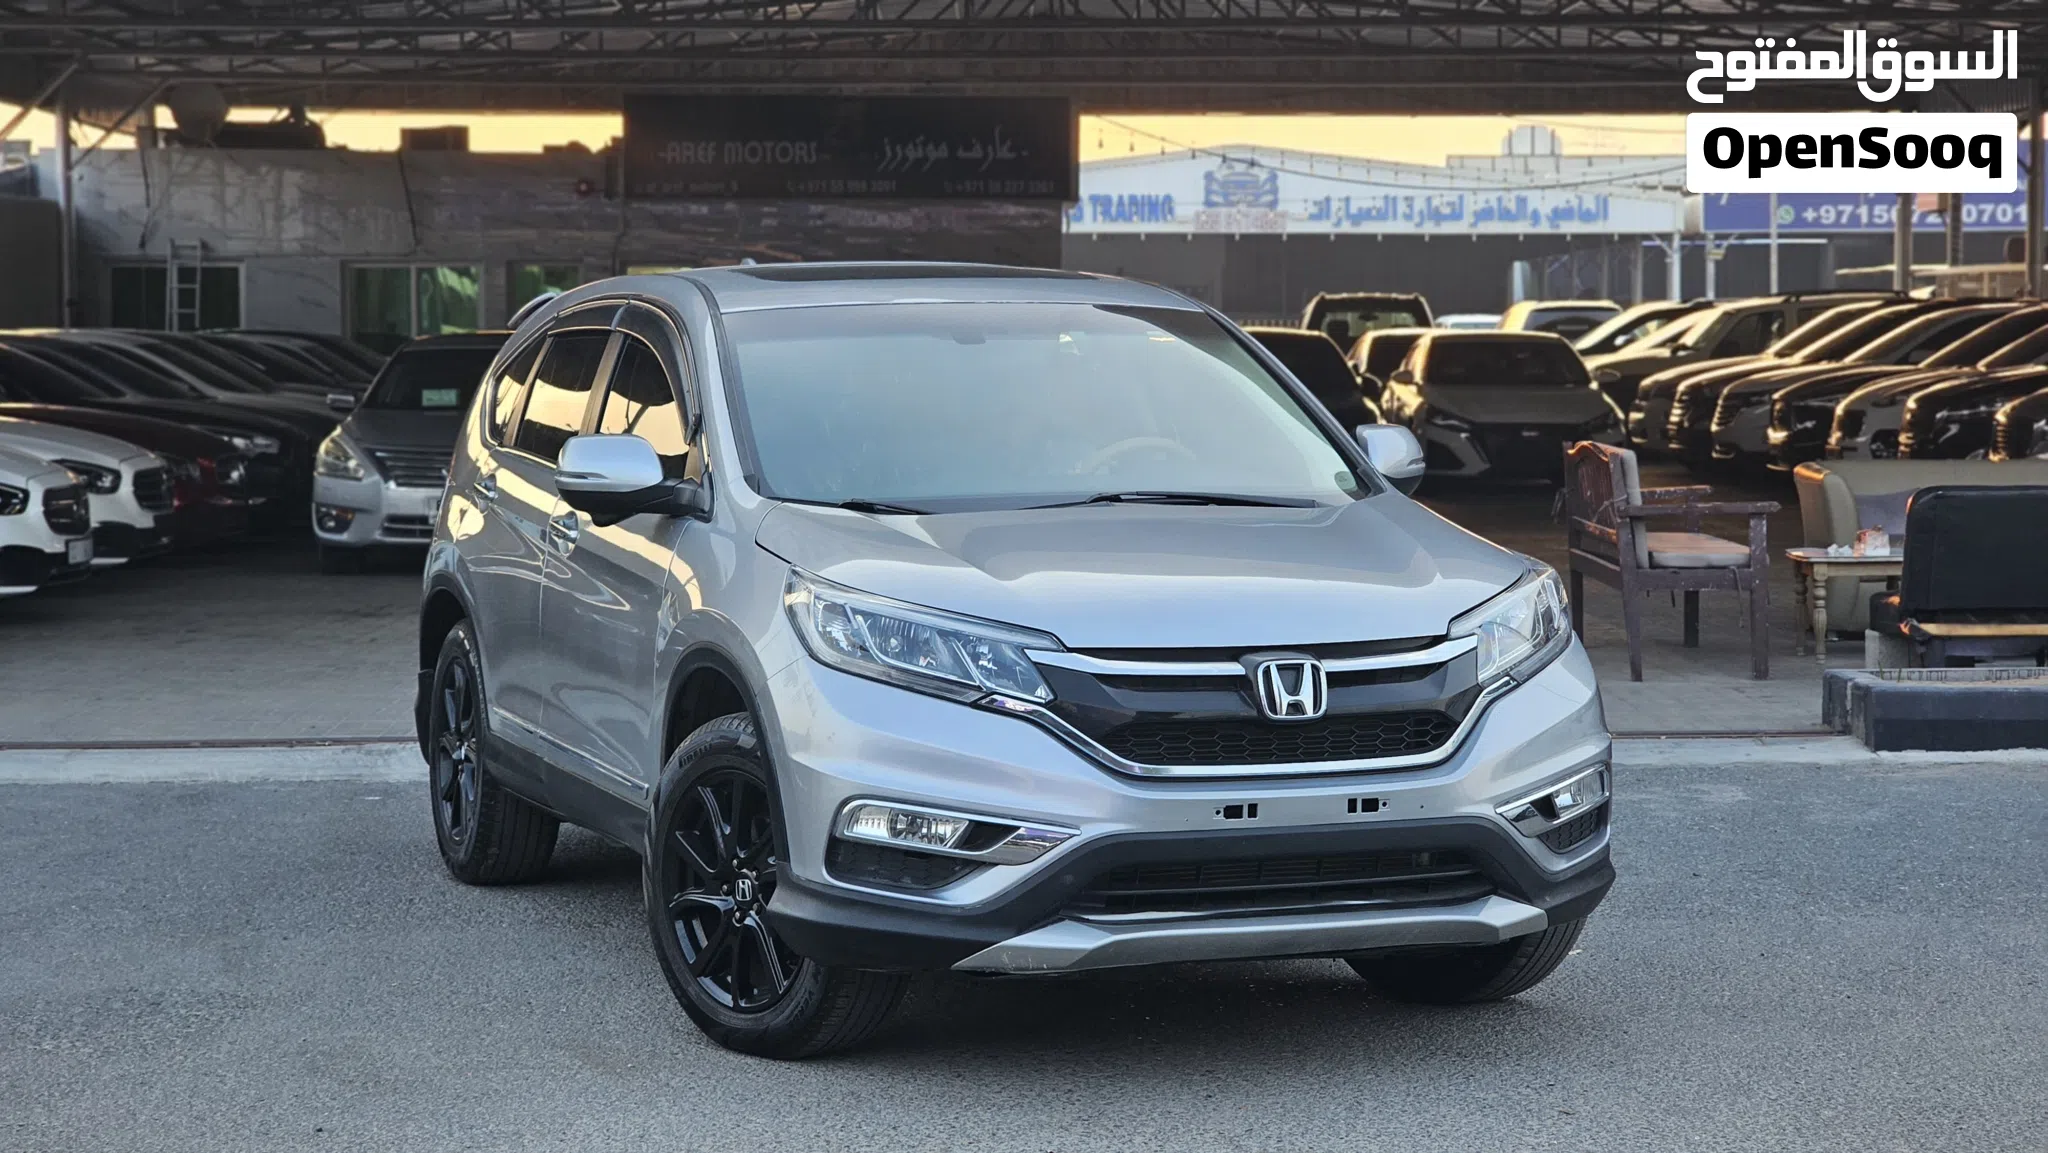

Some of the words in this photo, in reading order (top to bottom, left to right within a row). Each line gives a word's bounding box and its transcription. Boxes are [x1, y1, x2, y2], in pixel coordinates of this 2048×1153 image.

[876, 134, 949, 173] موتورز
[956, 124, 1017, 173] عارف
[1089, 193, 1175, 223] TRADING
